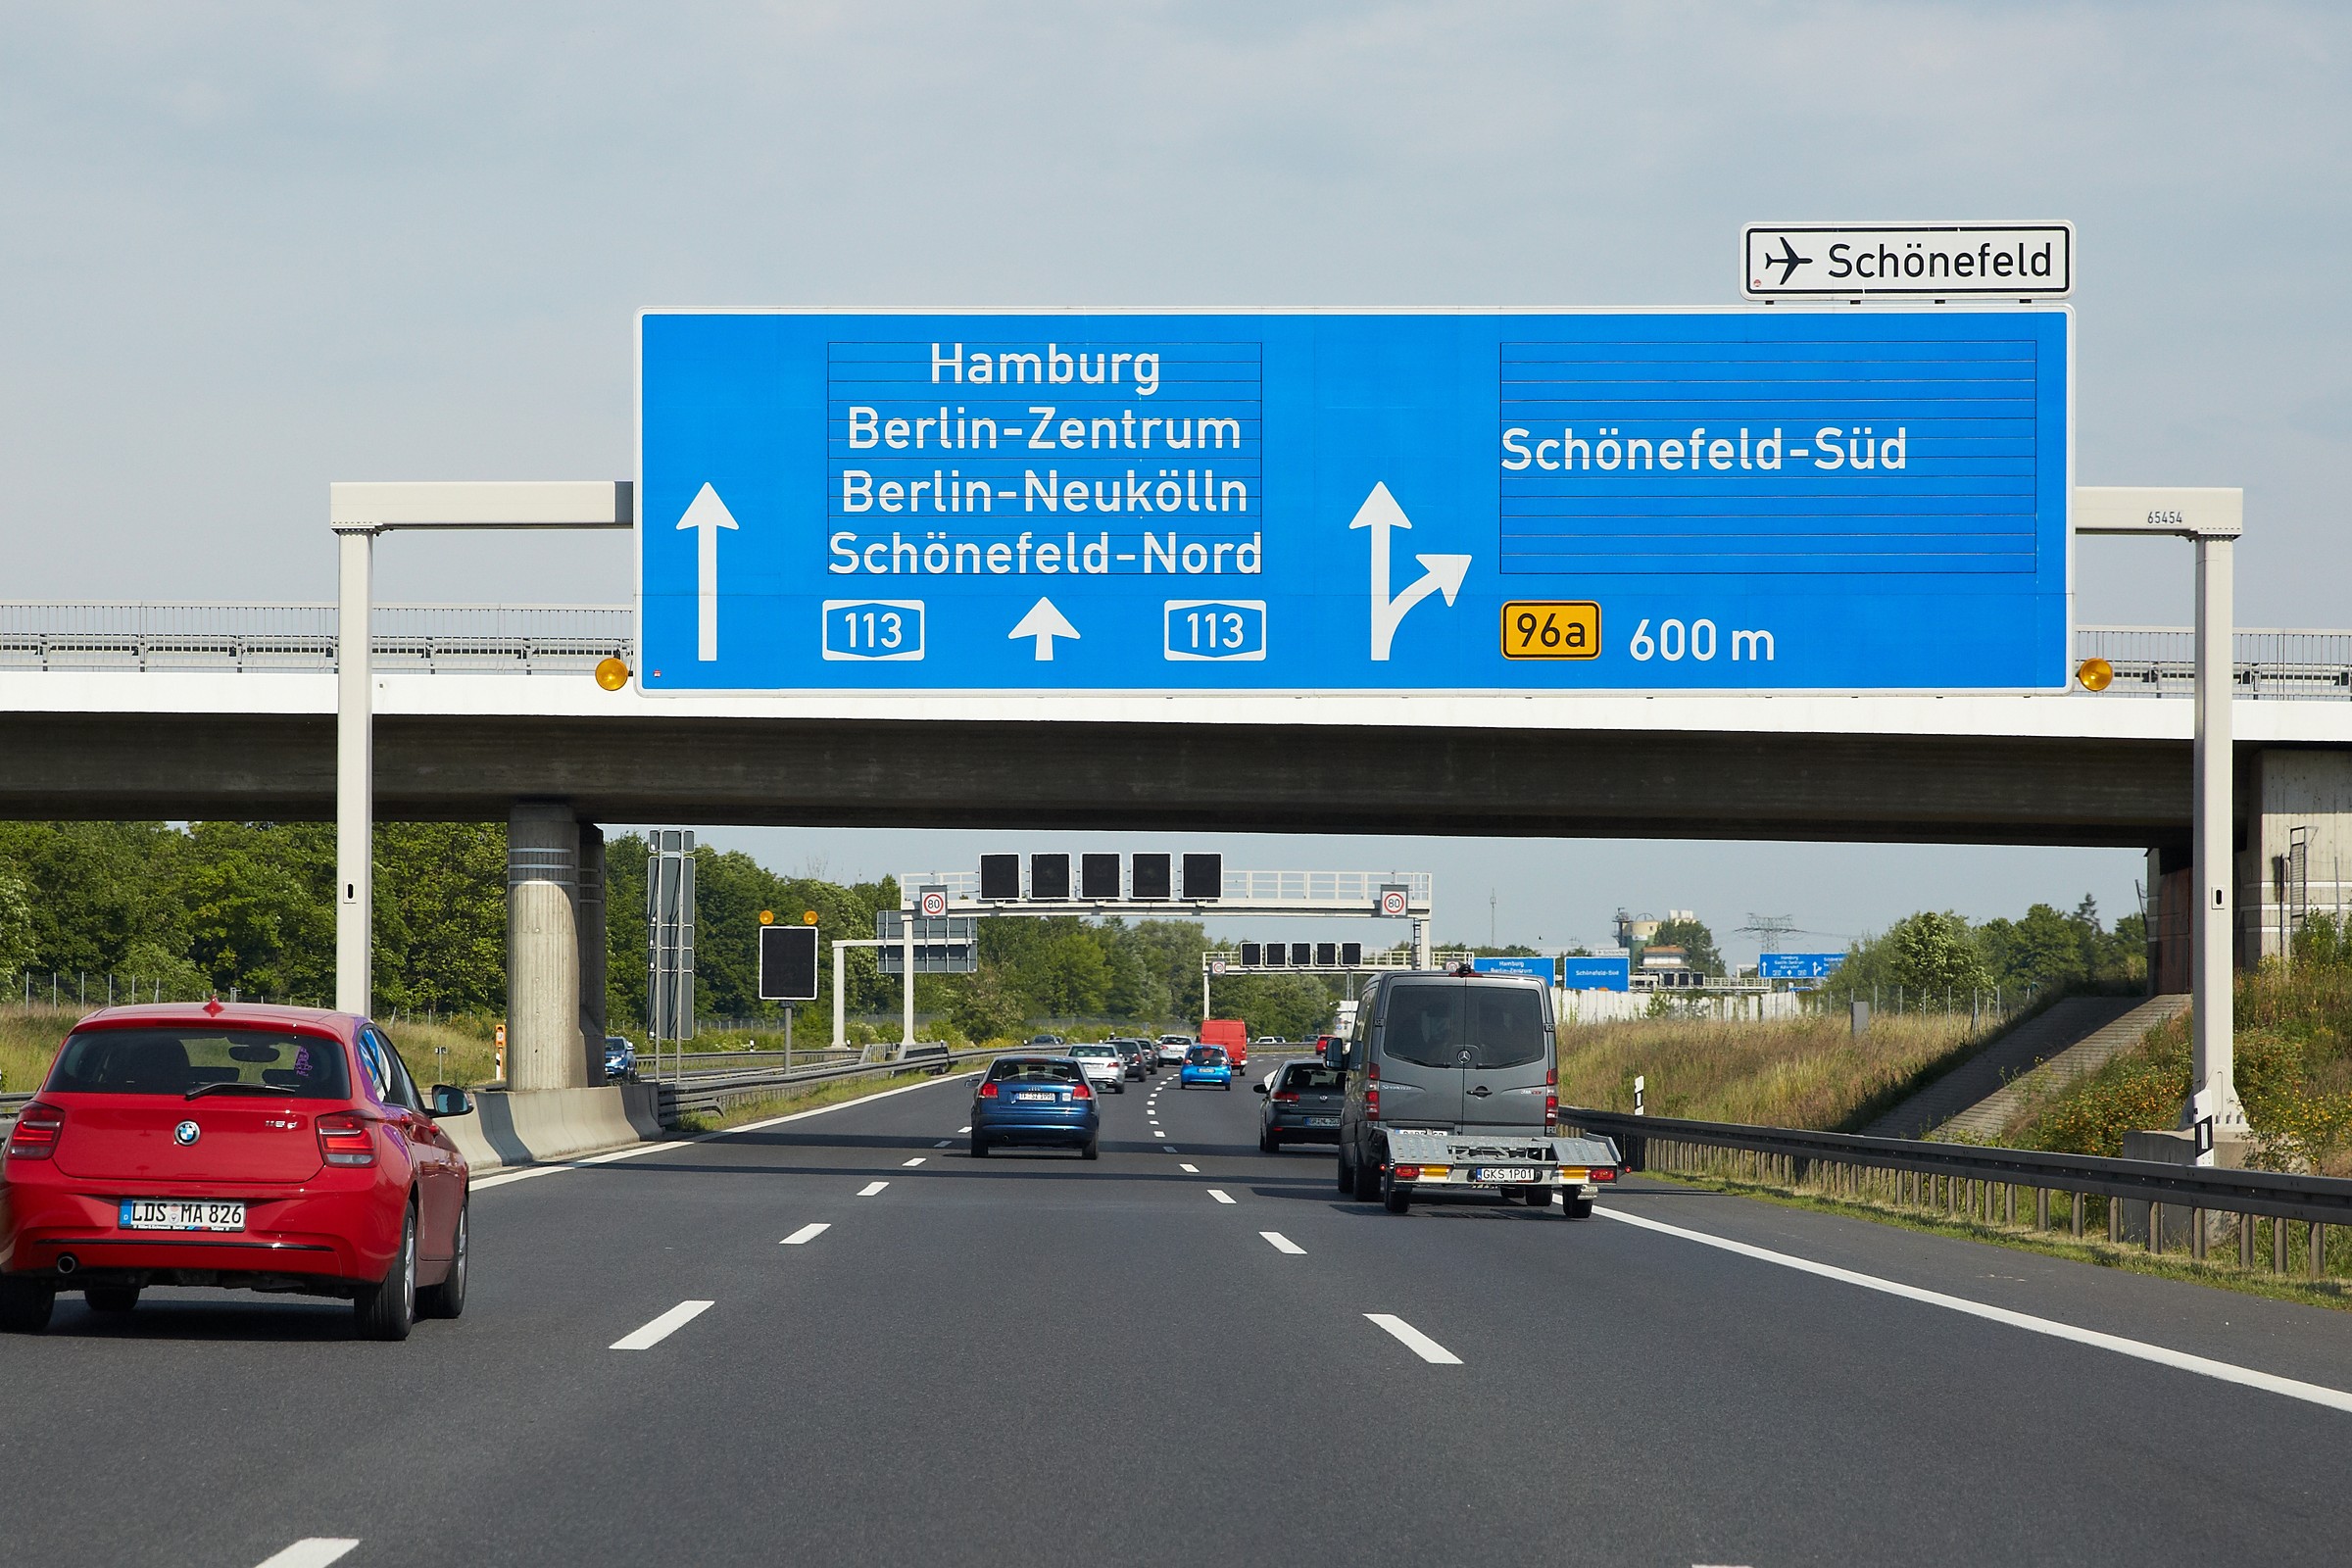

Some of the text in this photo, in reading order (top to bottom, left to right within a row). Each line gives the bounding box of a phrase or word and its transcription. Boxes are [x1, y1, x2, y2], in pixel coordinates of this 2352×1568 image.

[1828, 242, 2051, 278] Schönefeld
[931, 342, 1160, 396] Hamburg
[849, 406, 1241, 450] Berlin-Zentrum
[1501, 426, 1906, 470] Schönefeld-Süd
[843, 469, 1248, 513] Berlin-Neukölln
[2147, 512, 2182, 524] 65454
[829, 531, 1262, 574] Schönefeld-Nord
[845, 613, 903, 649] 113
[1187, 613, 1244, 649] 113
[1517, 613, 1586, 649] 96a
[1630, 618, 1775, 662] 600 m
[927, 900, 940, 908] 80
[1388, 899, 1399, 907] 80
[1483, 1169, 1505, 1179] GKS
[132, 1202, 242, 1224] LDS MA 826
